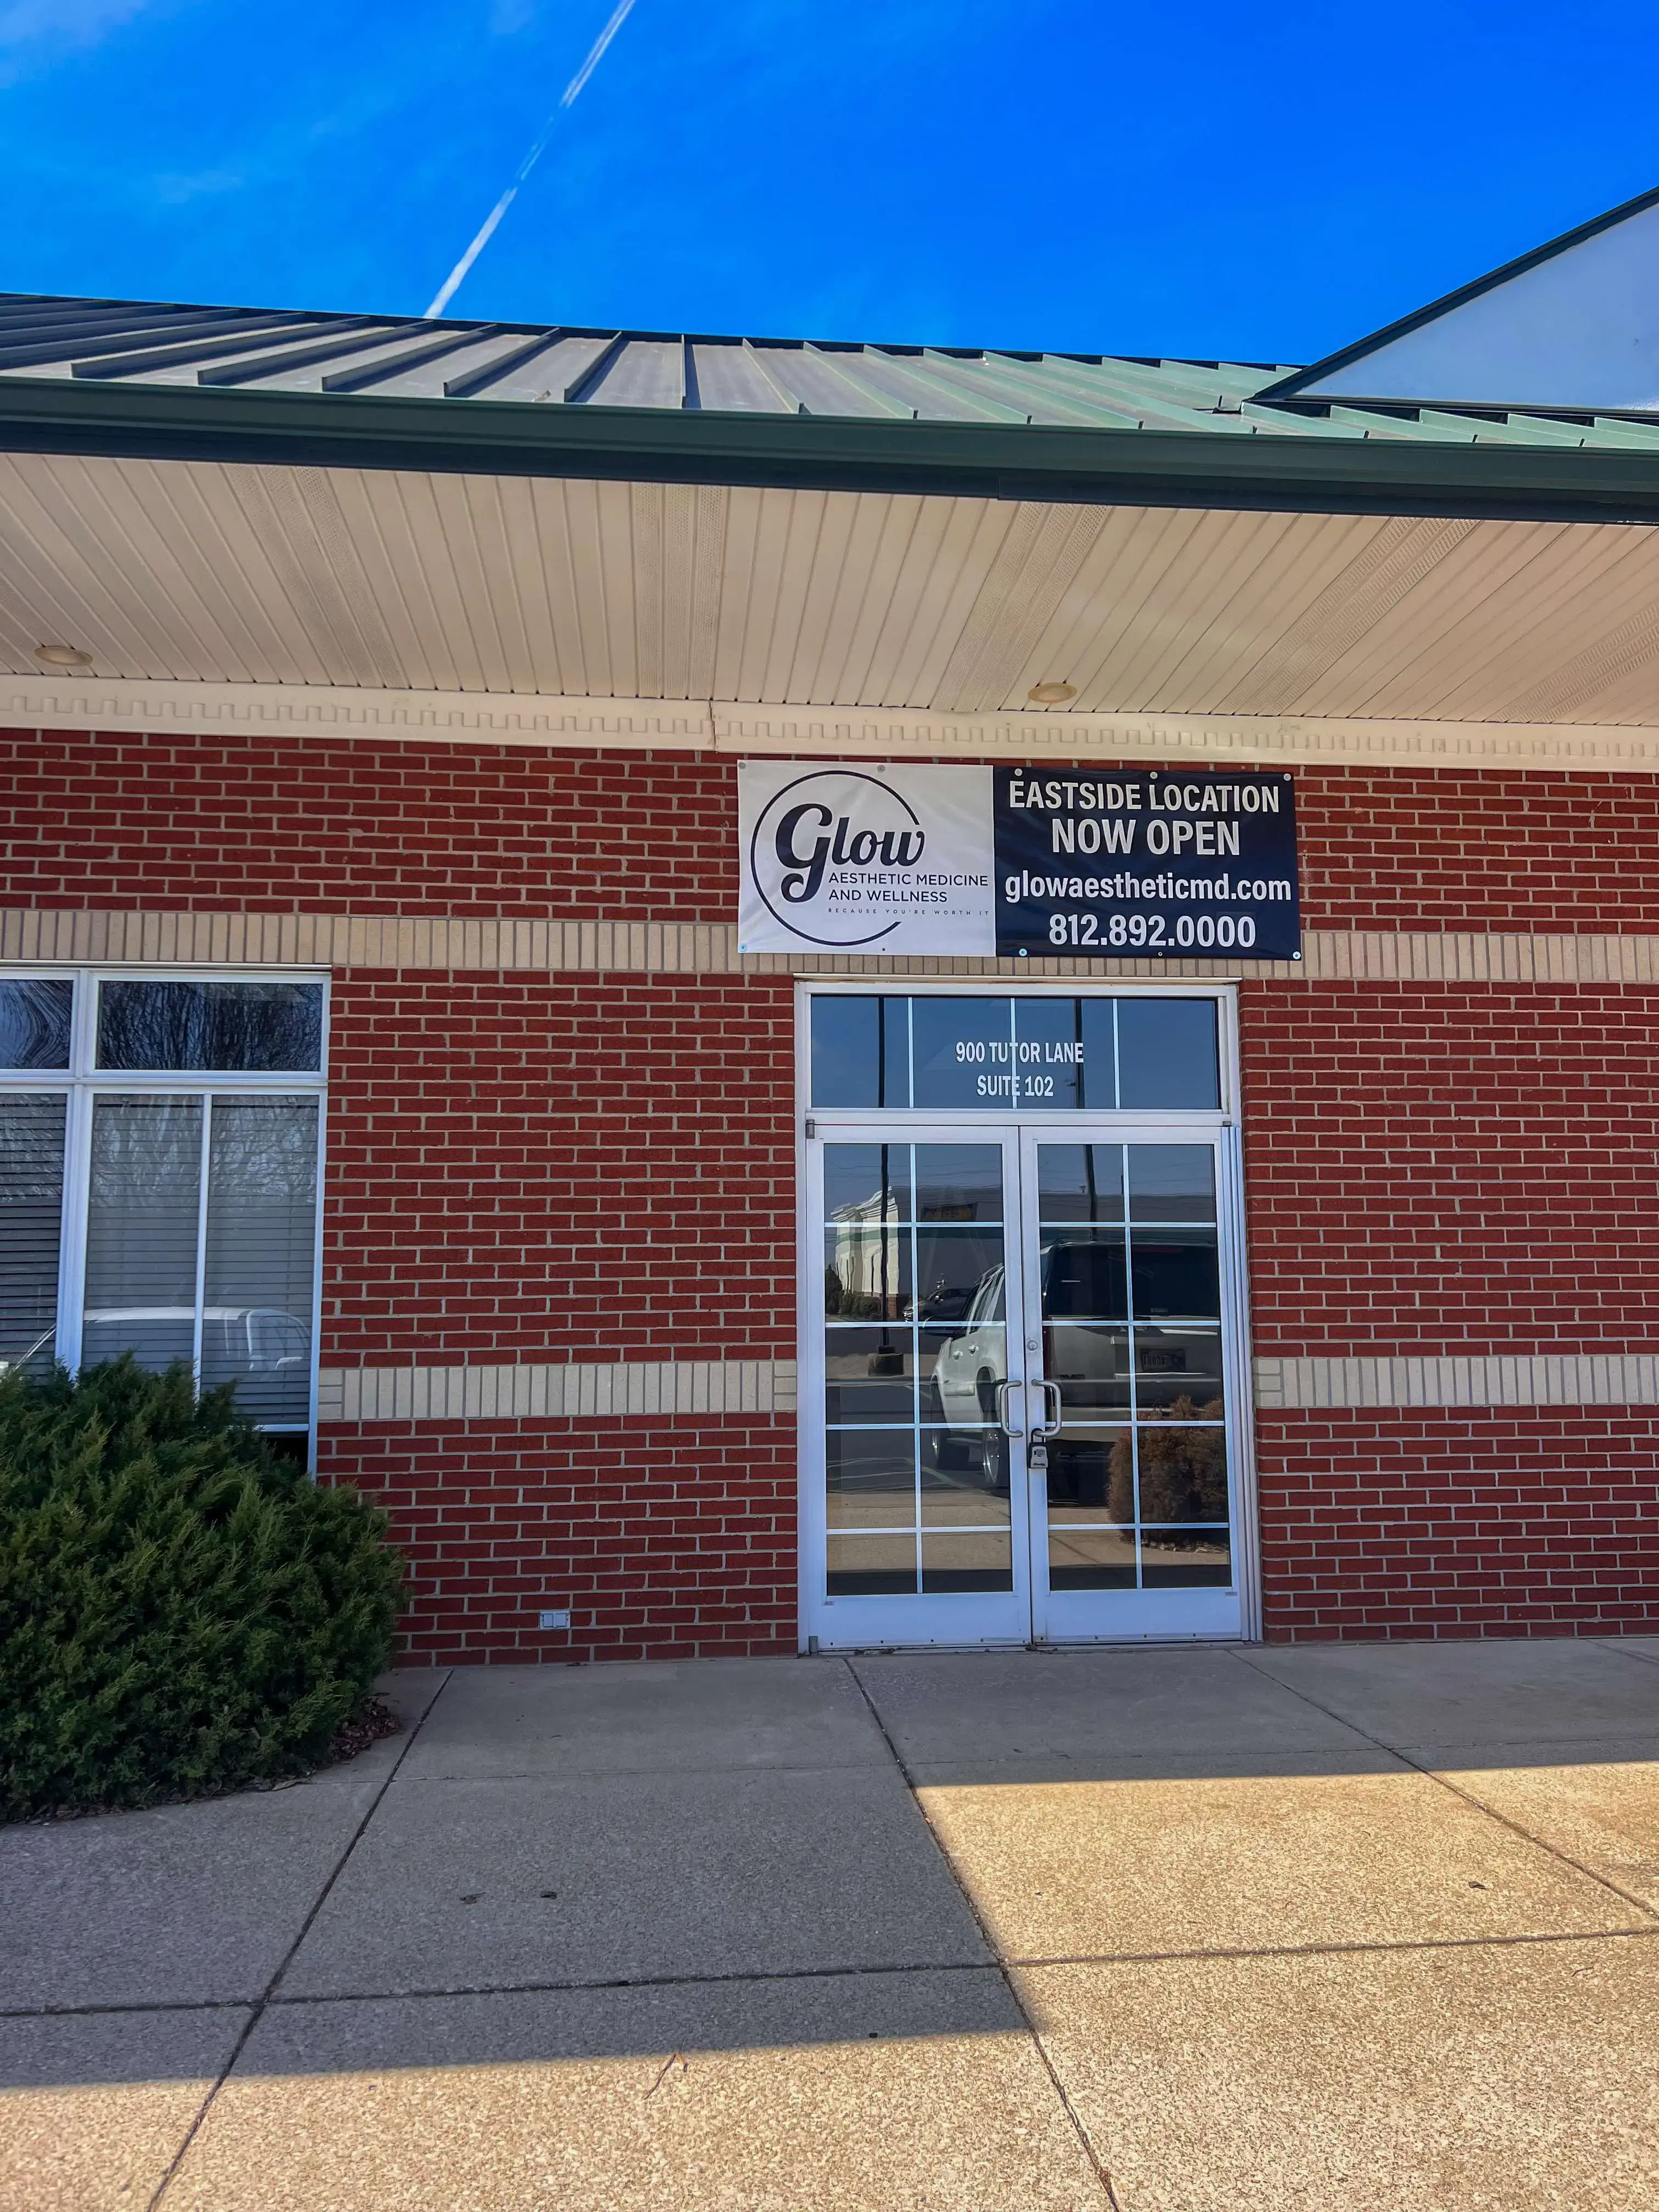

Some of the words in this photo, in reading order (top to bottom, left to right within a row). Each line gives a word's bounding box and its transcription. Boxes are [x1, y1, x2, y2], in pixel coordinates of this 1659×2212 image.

[1009, 781, 1142, 810] EASTSIDE
[1150, 784, 1279, 813] LOCATION
[775, 803, 925, 903] Glow
[1052, 819, 1136, 854] NOW
[1147, 820, 1240, 855] OPEN
[828, 872, 911, 884] AESTHETIC
[917, 874, 988, 886] MEDICINE
[1005, 870, 1291, 903] glowaestheticmd.com
[828, 890, 861, 900] AND
[867, 891, 947, 901] WELLNESS
[1049, 913, 1256, 947] 812.892.0000
[956, 1042, 985, 1063] 900
[988, 1042, 1040, 1063] TUTOR
[1045, 1042, 1084, 1063] LANE
[977, 1075, 1020, 1096] SUITE
[1025, 1076, 1054, 1097] 102
